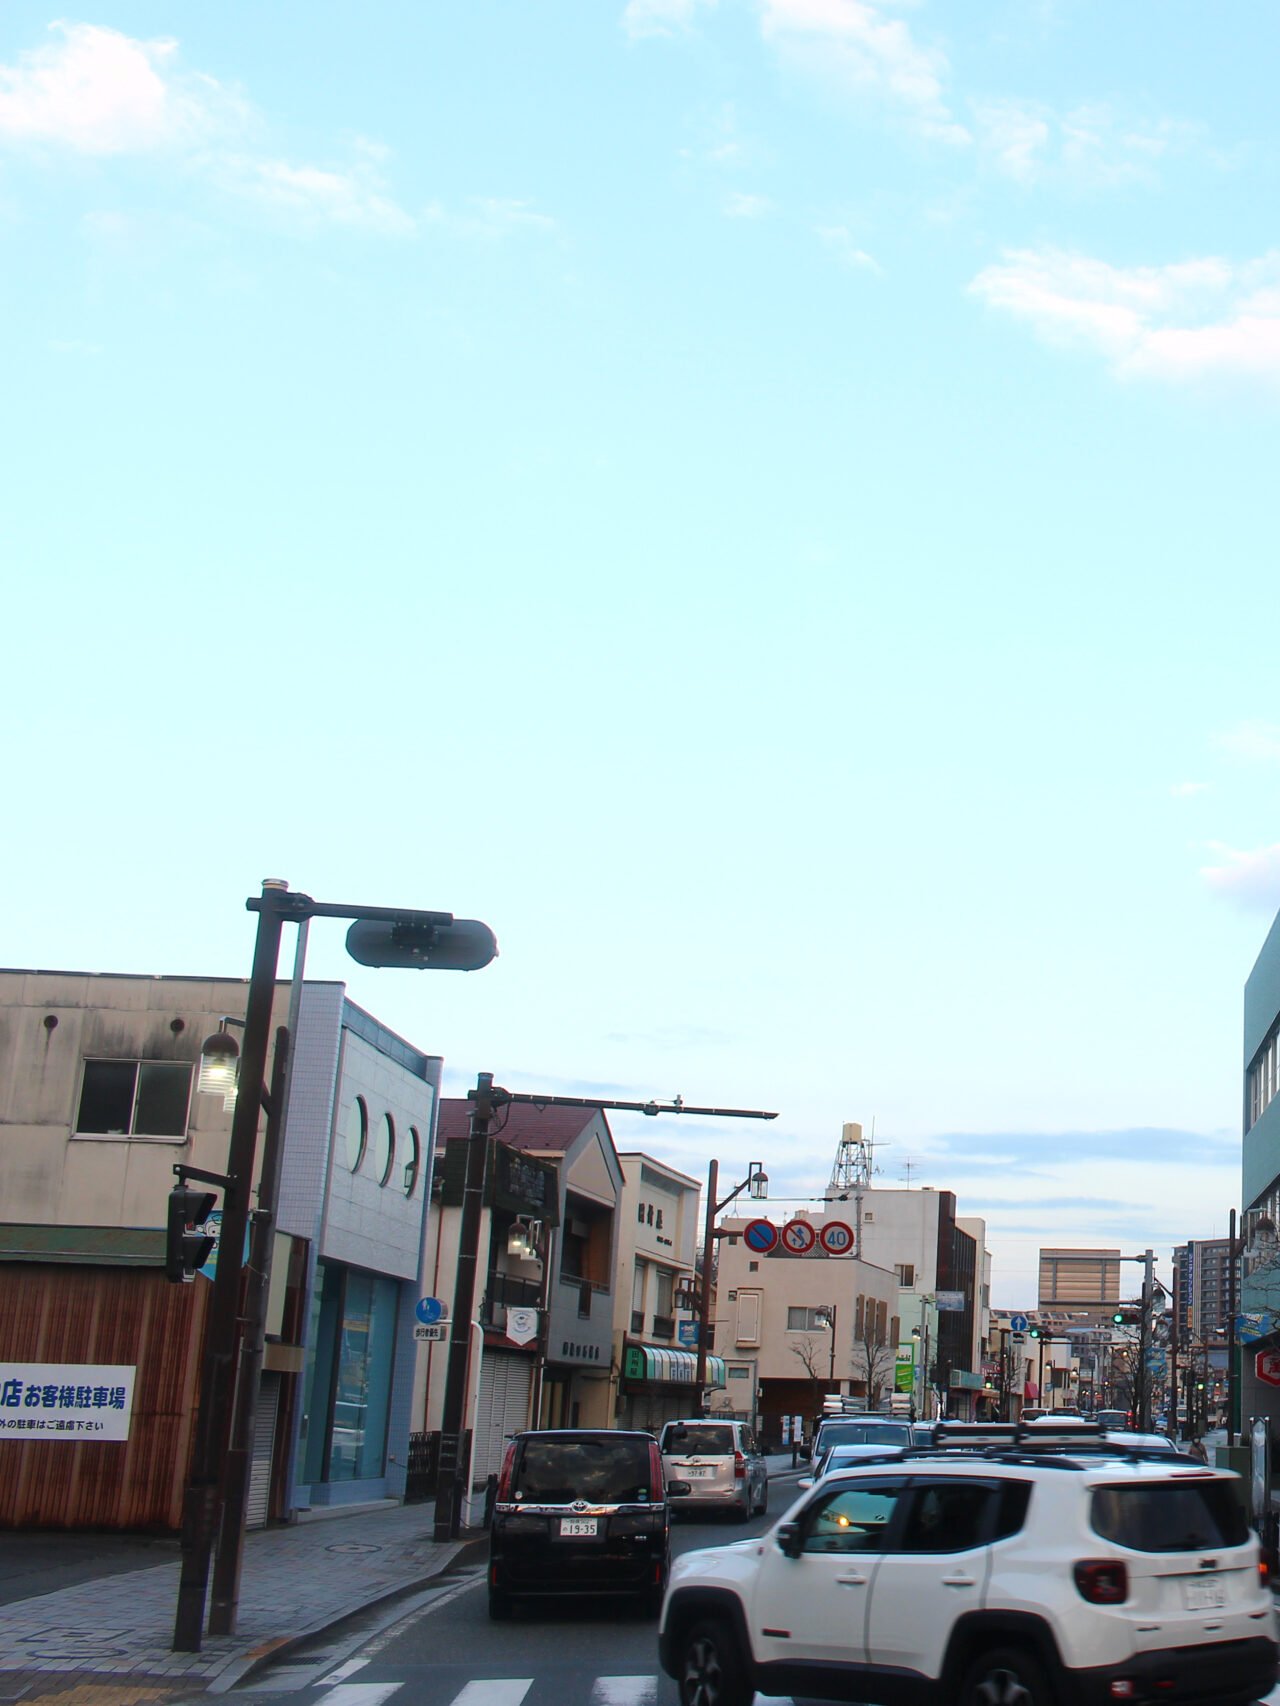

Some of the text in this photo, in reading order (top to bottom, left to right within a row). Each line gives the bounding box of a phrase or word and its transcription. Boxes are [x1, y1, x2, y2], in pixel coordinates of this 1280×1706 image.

[827, 1231, 846, 1246] 40
[0, 1378, 126, 1410] 店お客様駐車場
[570, 1524, 596, 1534] 19-35
